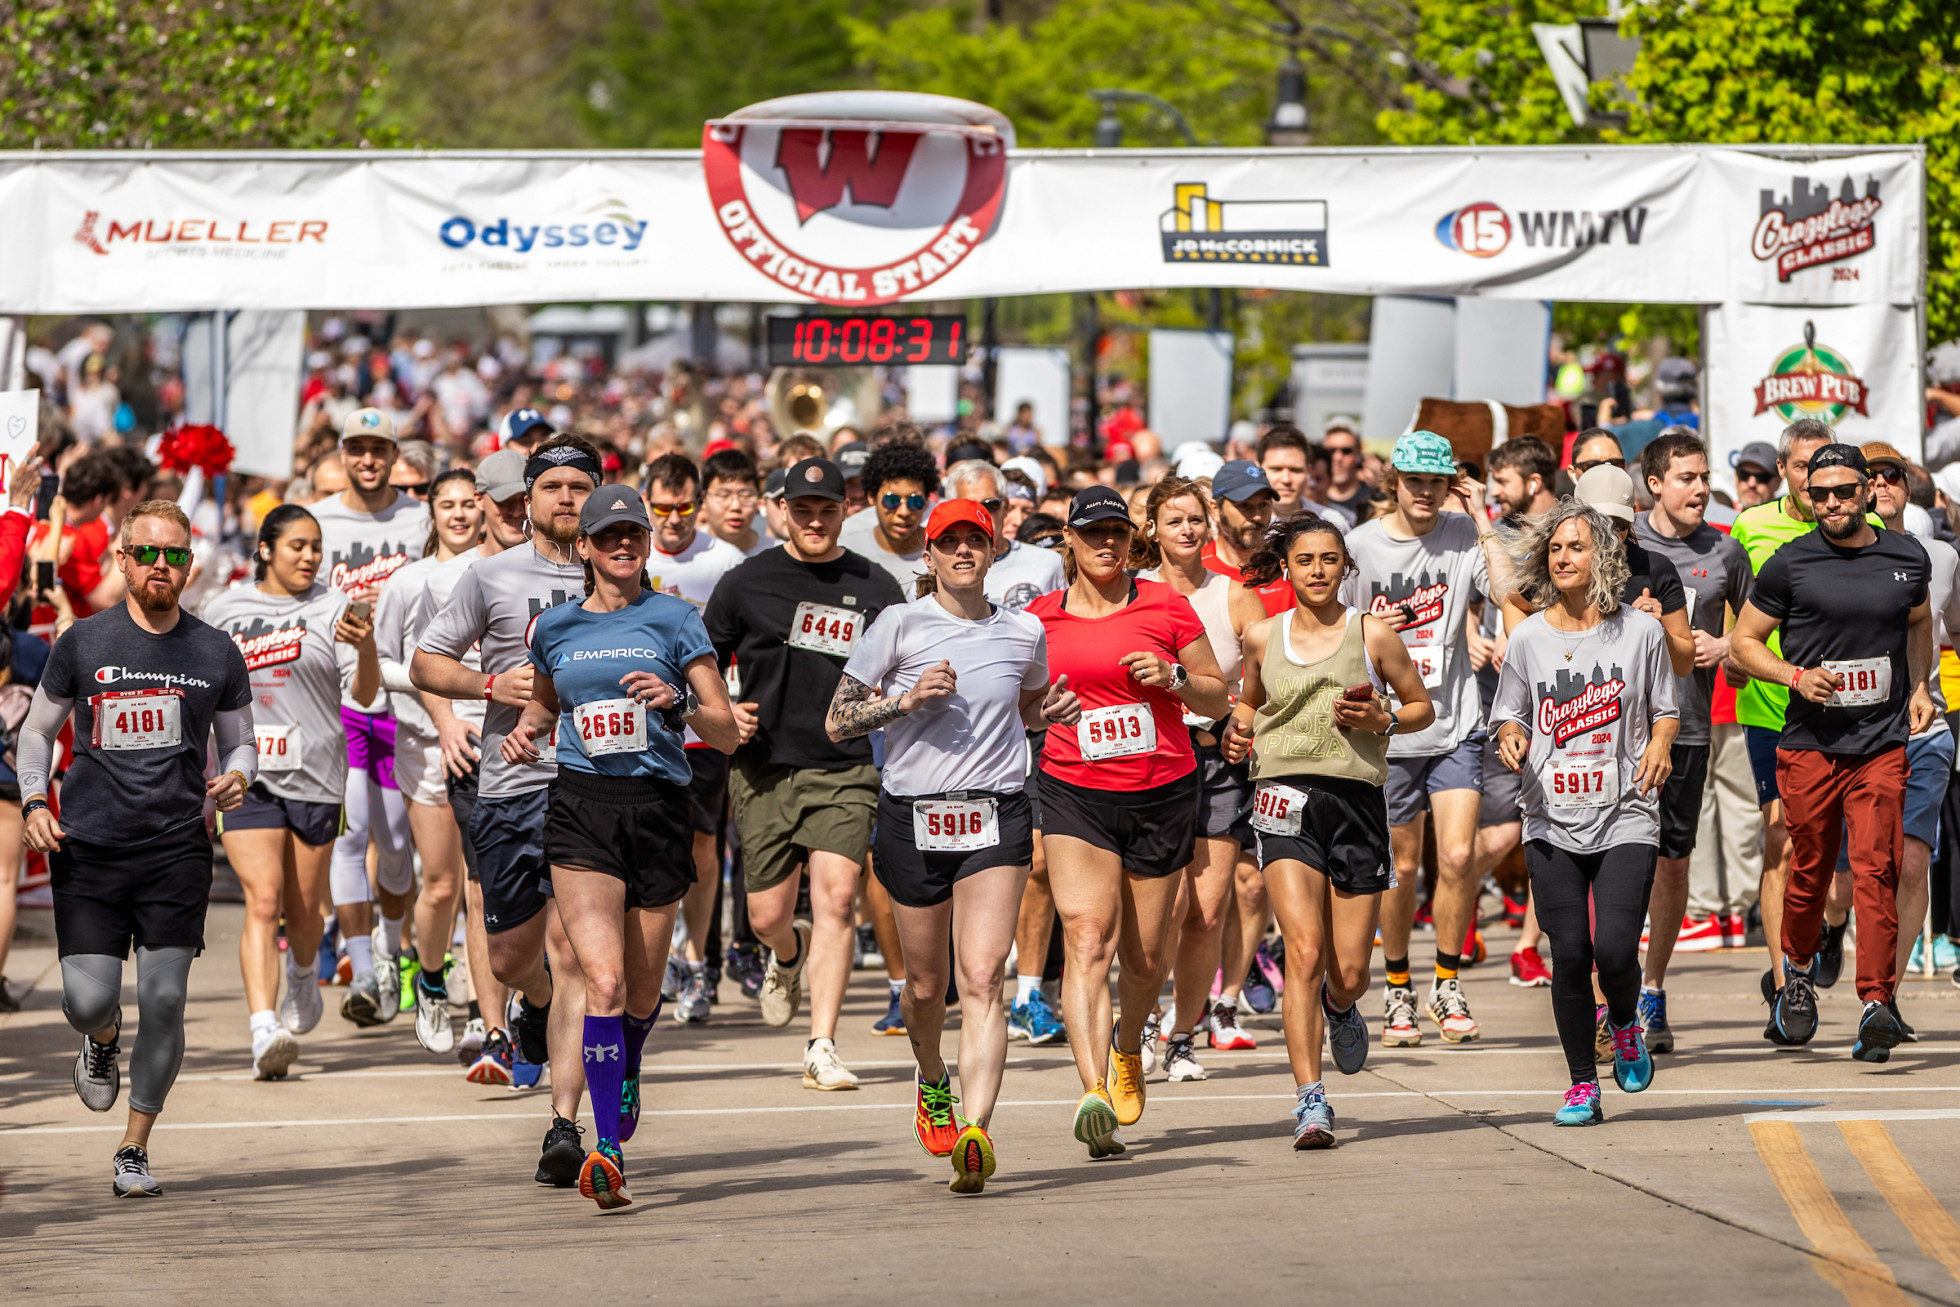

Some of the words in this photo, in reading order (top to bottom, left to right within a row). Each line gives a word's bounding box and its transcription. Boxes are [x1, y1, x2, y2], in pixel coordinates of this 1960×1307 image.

[106, 220, 329, 243] MUELLER
[439, 215, 648, 253] Odyssey
[1458, 210, 1507, 252] 15
[1518, 206, 1648, 247] WMTV
[1752, 195, 1882, 261] Crazylegs
[718, 199, 867, 300] OFFICIAL
[872, 213, 981, 298] START
[1781, 230, 1869, 270] CLASSIC
[792, 318, 961, 363] 10:08:31
[1764, 376, 1819, 403] BREW
[1820, 373, 1861, 403] PUB
[1102, 498, 1125, 511] happy
[801, 613, 854, 643] 6449
[1416, 629, 1434, 639] 2024
[573, 648, 657, 661] EMPIRICO
[94, 665, 211, 689] Champion
[1275, 671, 1344, 699] WILL
[115, 709, 165, 734] 4181
[1538, 678, 1626, 736] Crazylegs
[581, 712, 635, 741] 2665
[1089, 715, 1142, 744] 5913
[1279, 713, 1332, 736] FOR
[1557, 705, 1618, 739] CLASSIC
[1263, 734, 1346, 759] PIZZA
[1591, 732, 1612, 745] 2024
[1554, 770, 1604, 794] 5917
[1254, 789, 1290, 820] 5915
[928, 811, 982, 836] 5916
